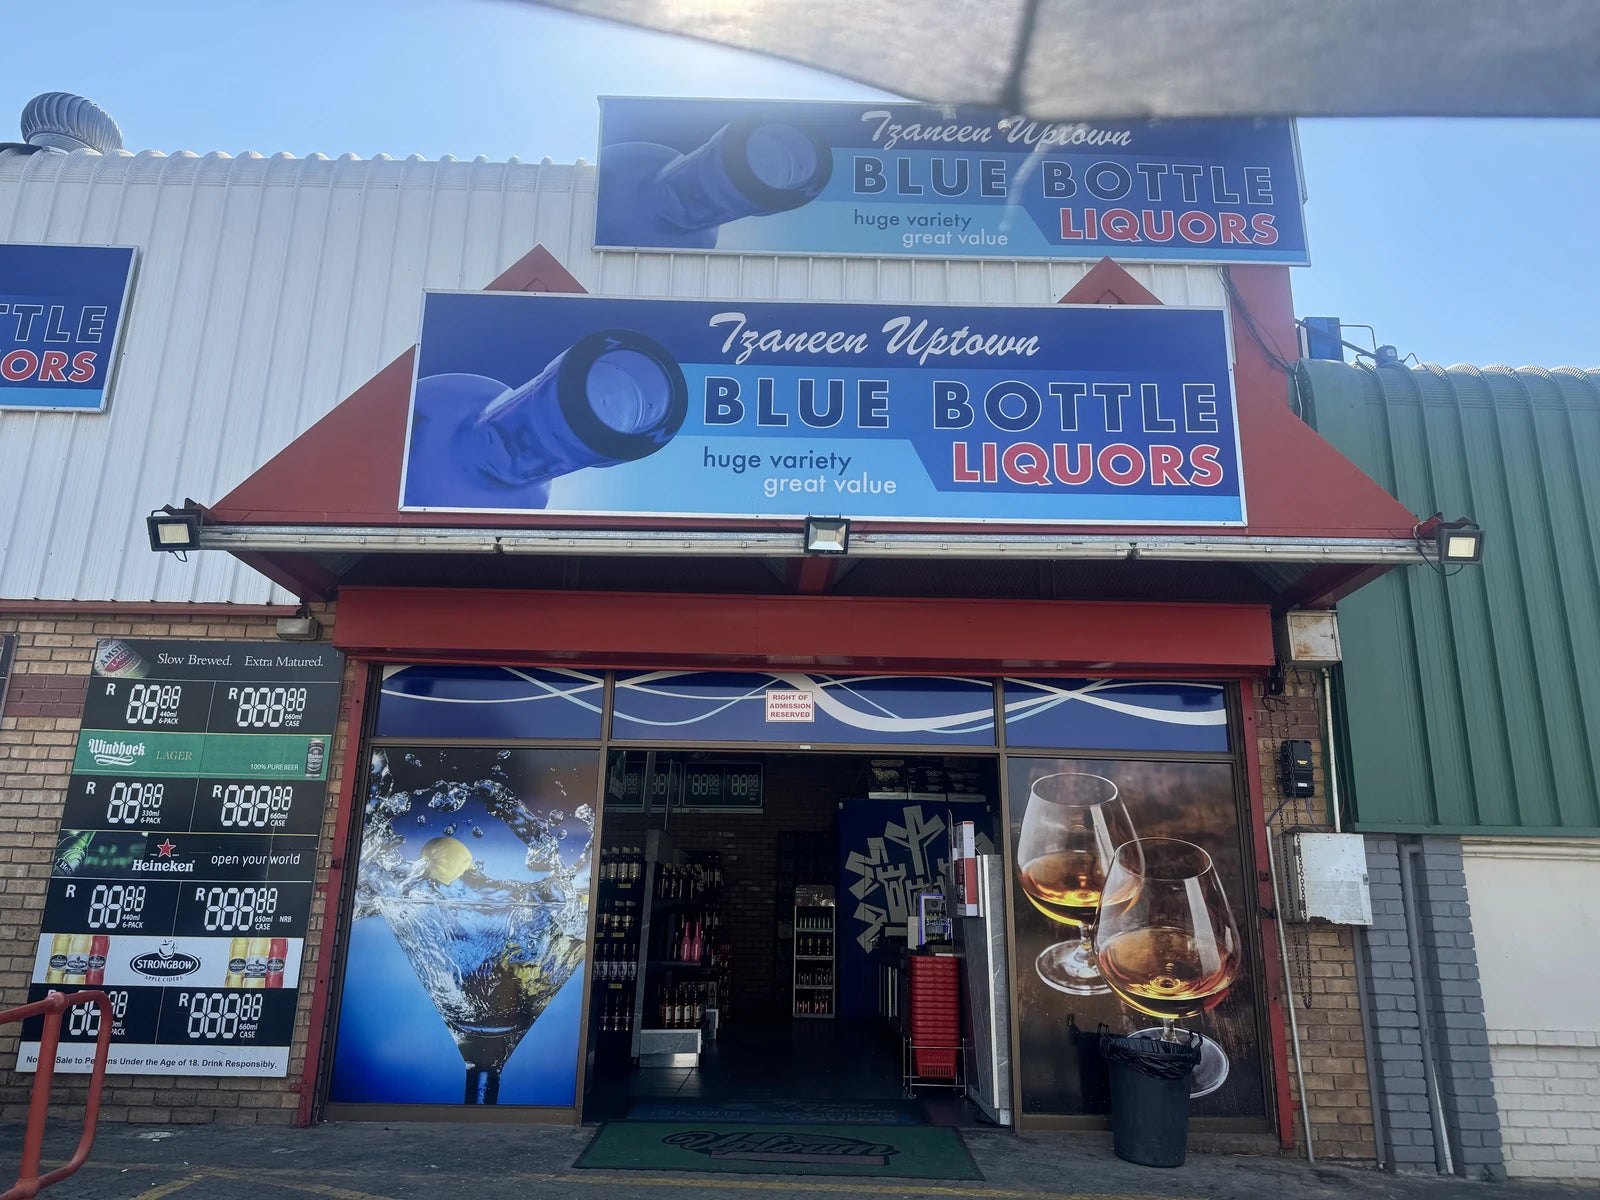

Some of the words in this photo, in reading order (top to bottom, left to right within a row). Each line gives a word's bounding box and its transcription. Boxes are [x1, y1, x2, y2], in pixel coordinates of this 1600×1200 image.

[861, 110, 992, 150] Tzaneen
[1000, 115, 1132, 152] Uptown
[853, 156, 1007, 197] BLUE
[1042, 161, 1273, 205] BOTTLE
[854, 209, 900, 229] huge
[907, 212, 972, 231] variety
[1060, 208, 1279, 245] LIQUORS
[902, 231, 952, 248] great
[958, 229, 1008, 245] value
[709, 312, 868, 365] Tzaneen
[882, 316, 1040, 365] Uptown
[0, 349, 98, 383] ORS
[703, 376, 889, 428] BLUE
[933, 380, 1219, 433] BOTTLE
[703, 446, 761, 473] huge
[769, 450, 852, 475] variety
[953, 441, 1224, 487] LIQUORS
[764, 476, 826, 497] great
[833, 472, 897, 494] value
[157, 653, 184, 665] Slow
[187, 654, 232, 666] Brewed.
[245, 656, 273, 667] Extra
[275, 656, 324, 667] Matured.
[105, 683, 116, 696] R
[228, 688, 239, 700] R
[88, 738, 146, 758] Windhoek
[156, 751, 193, 761] LAGER
[86, 782, 97, 795] R
[212, 785, 223, 798] R
[132, 859, 194, 872] Heineken
[211, 855, 239, 867] open
[242, 855, 267, 867] your
[270, 853, 301, 865] world
[65, 884, 76, 898] R
[195, 887, 206, 901] R
[279, 915, 292, 923] NRB
[136, 959, 195, 969] STRONGBOW
[178, 992, 190, 1007] R
[239, 1022, 258, 1030] 660ml
[26, 1055, 38, 1064] No
[55, 1056, 73, 1064] Sale
[119, 1057, 144, 1065] Under
[145, 1058, 158, 1066] the
[159, 1058, 176, 1068] Age
[178, 1058, 187, 1066] of
[189, 1059, 199, 1067] 18.
[201, 1059, 223, 1067] Drink
[225, 1060, 277, 1069] Responsibly.
